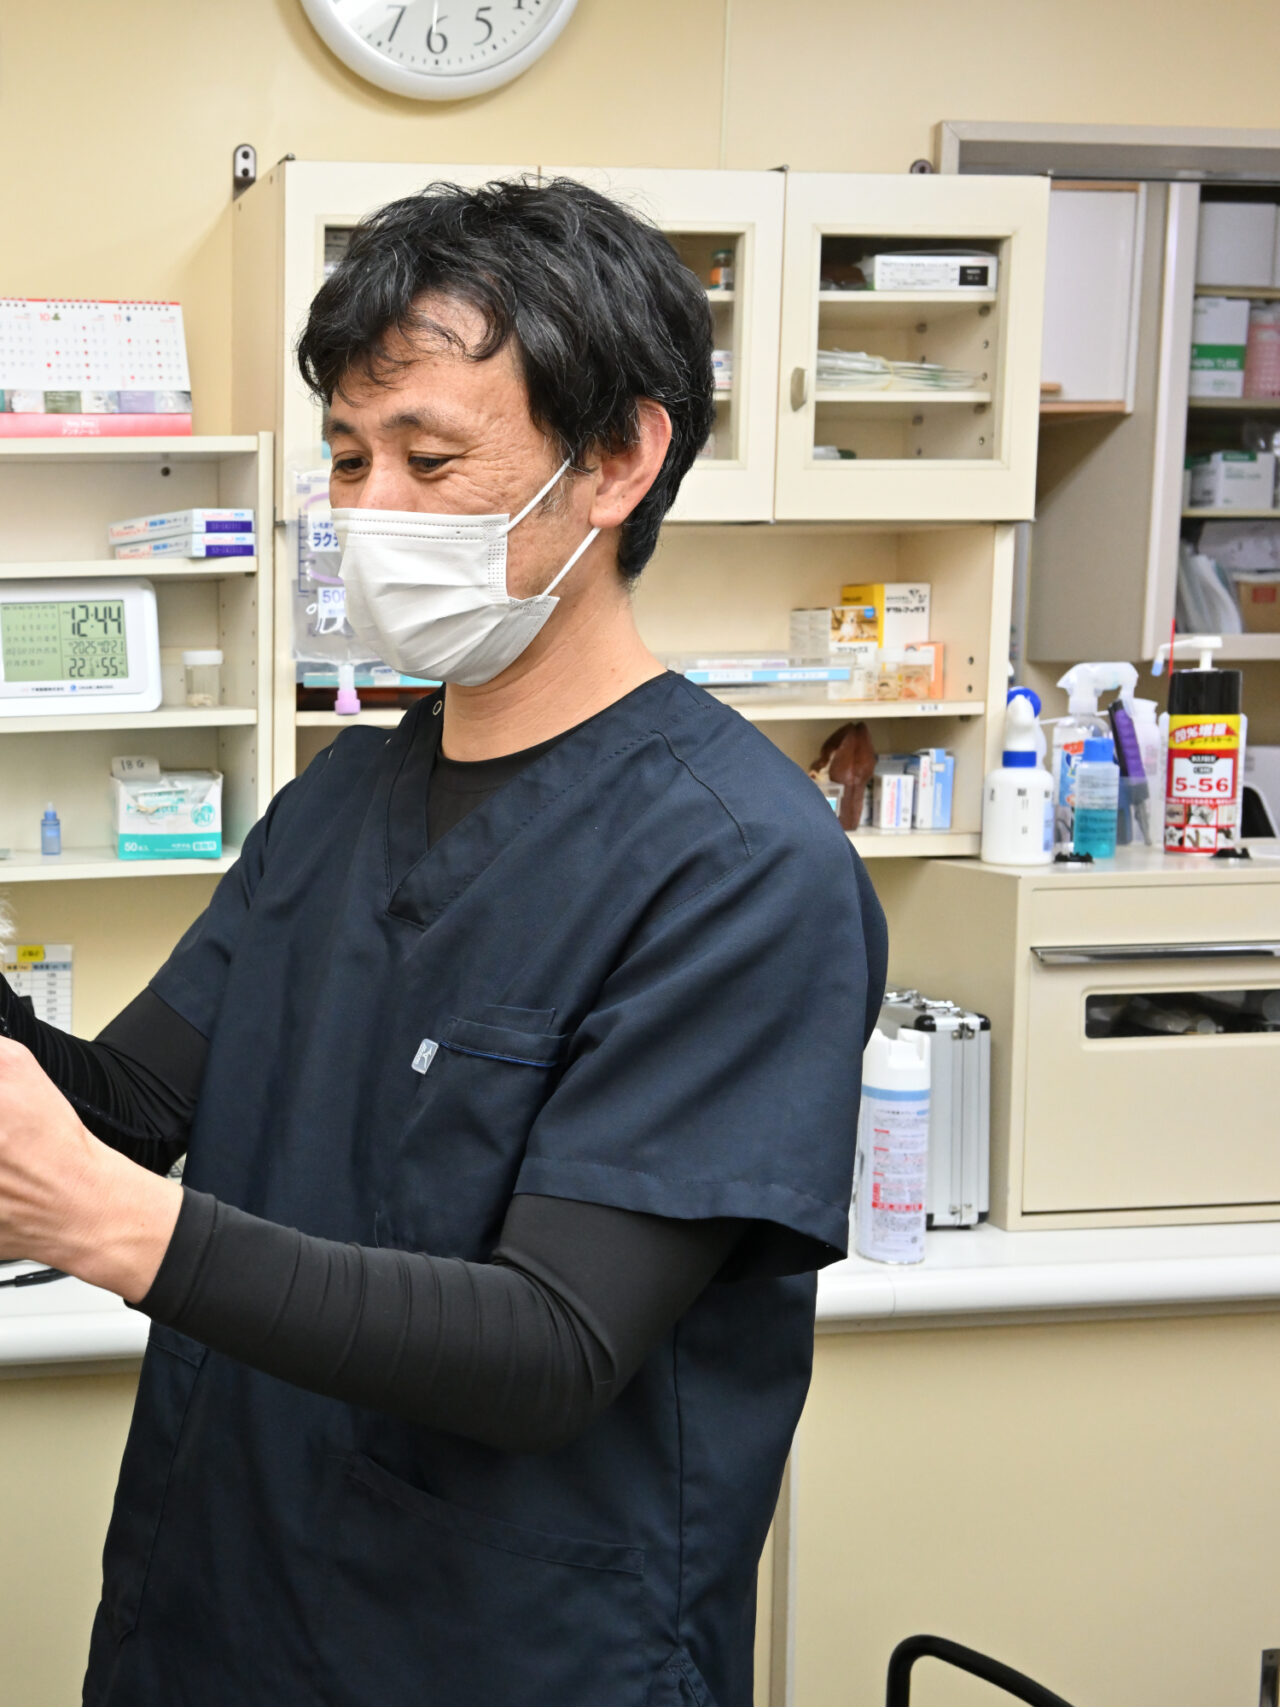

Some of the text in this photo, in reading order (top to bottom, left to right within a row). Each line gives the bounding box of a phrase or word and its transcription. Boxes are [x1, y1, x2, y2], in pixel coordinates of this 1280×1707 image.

[387, 5, 492, 54] 7 6 5
[40, 313, 51, 321] 10
[71, 604, 122, 638] 12:44
[68, 656, 118, 678] 22 55
[1175, 777, 1229, 793] 5-56
